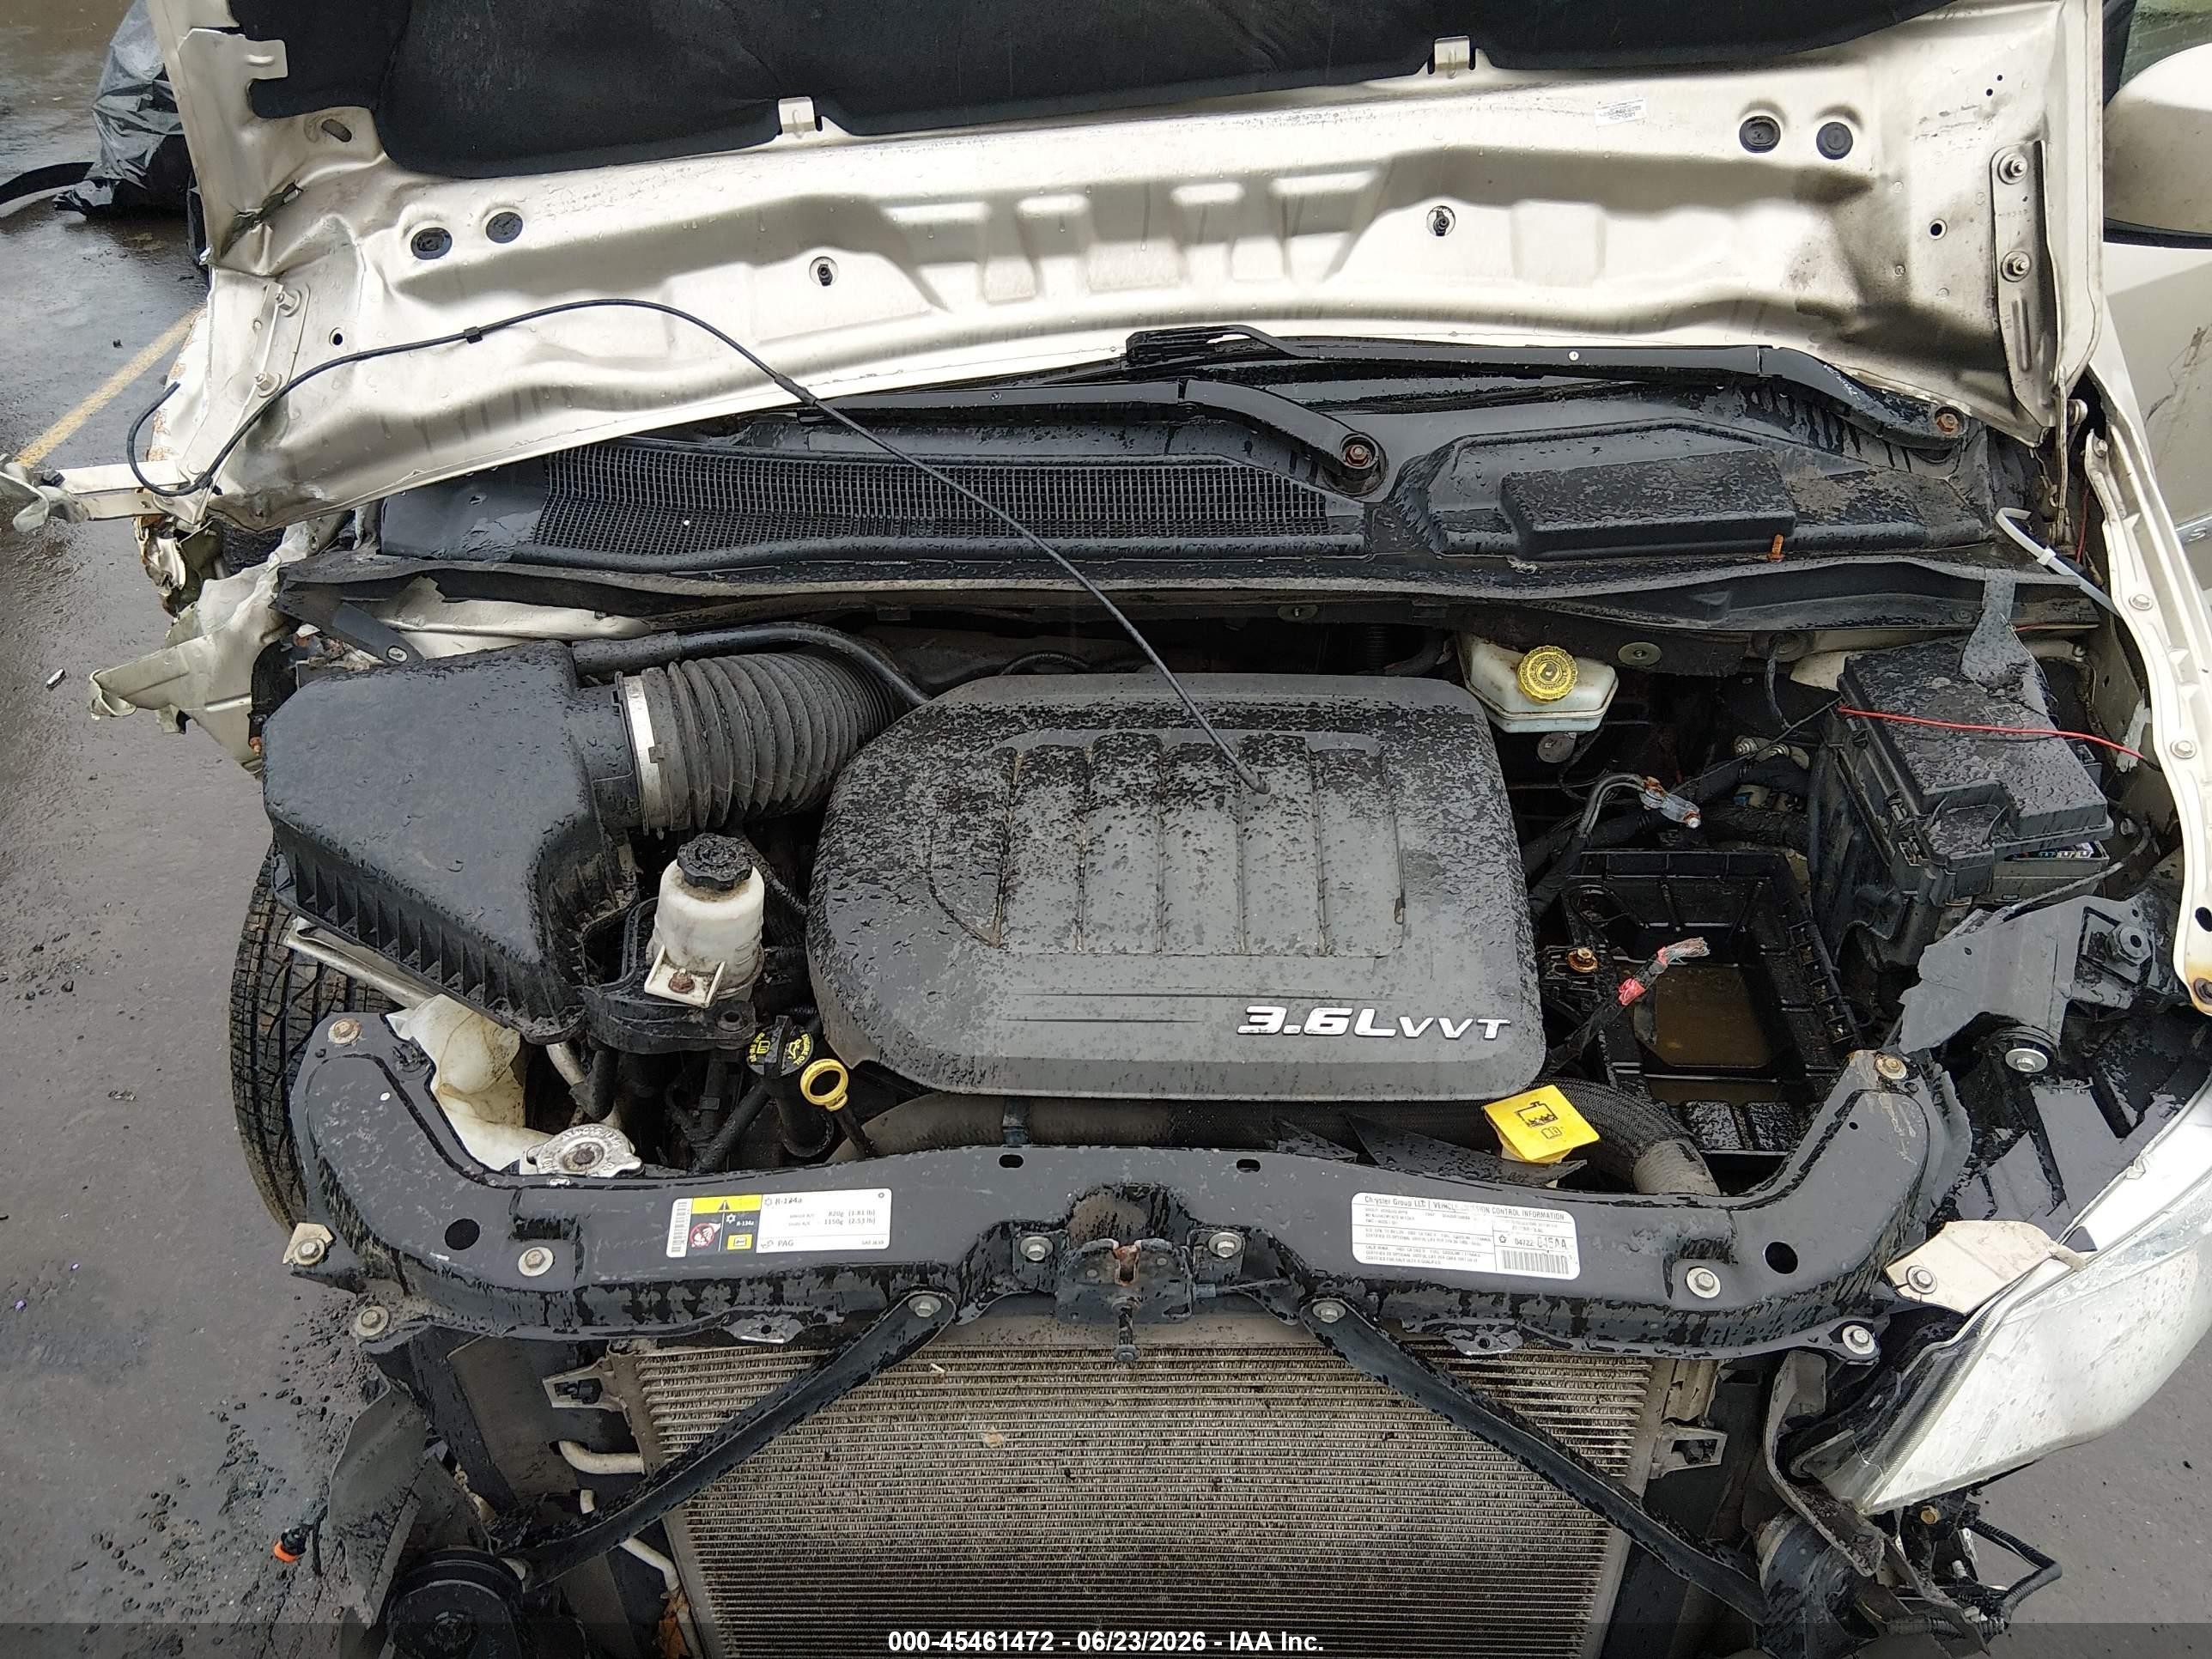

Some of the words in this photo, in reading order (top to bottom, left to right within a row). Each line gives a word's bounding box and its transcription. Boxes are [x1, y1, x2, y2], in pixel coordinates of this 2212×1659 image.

[801, 1033, 811, 1055] ENGINE
[793, 1056, 805, 1065] OIL
[1393, 1197, 1412, 1207] Group
[1492, 1206, 1520, 1216] CONTROL
[1522, 1209, 1565, 1220] INFORMATION
